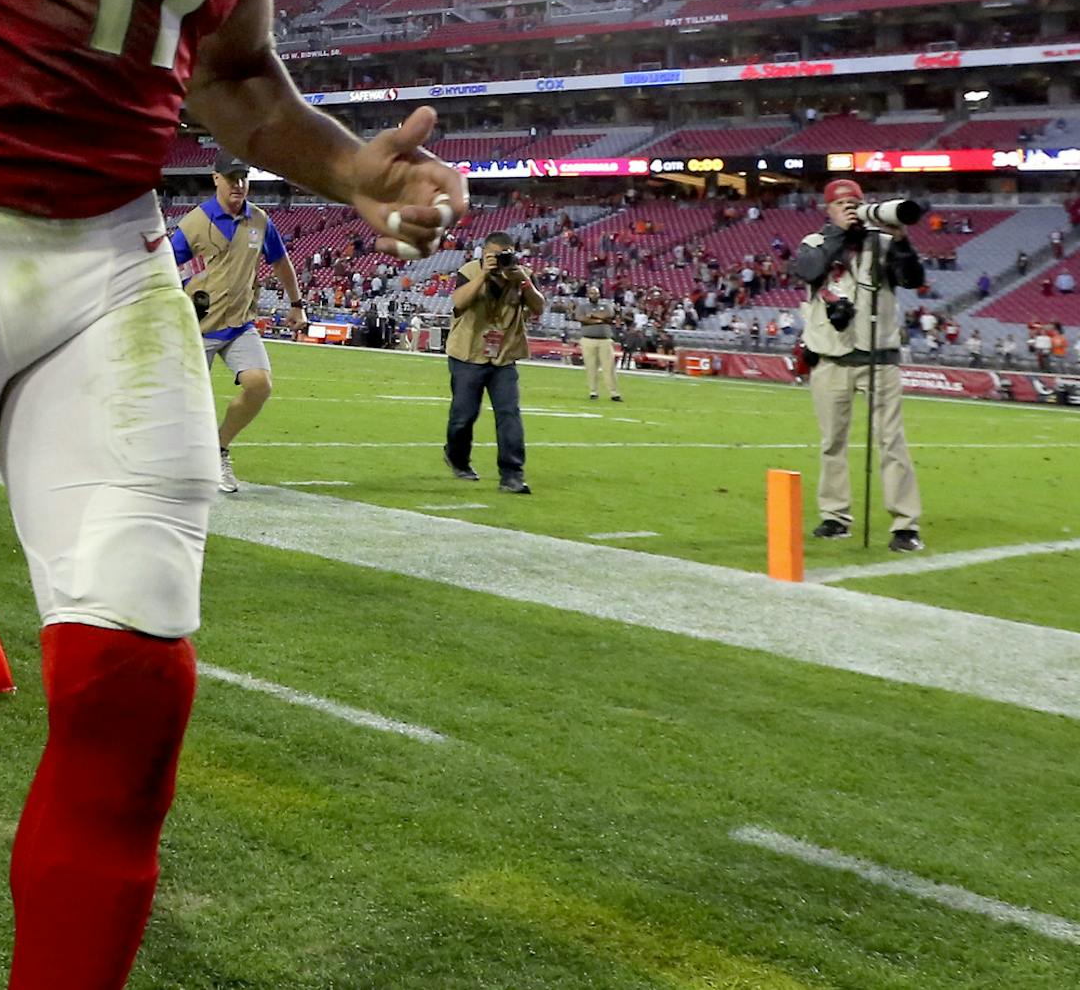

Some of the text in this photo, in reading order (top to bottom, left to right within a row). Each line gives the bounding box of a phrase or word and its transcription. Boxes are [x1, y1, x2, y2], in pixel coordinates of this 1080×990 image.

[684, 13, 729, 24] TILLMAN
[536, 78, 564, 91] COX
[444, 85, 487, 95] HYUNDAI
[349, 91, 387, 101] SAFEWAY
